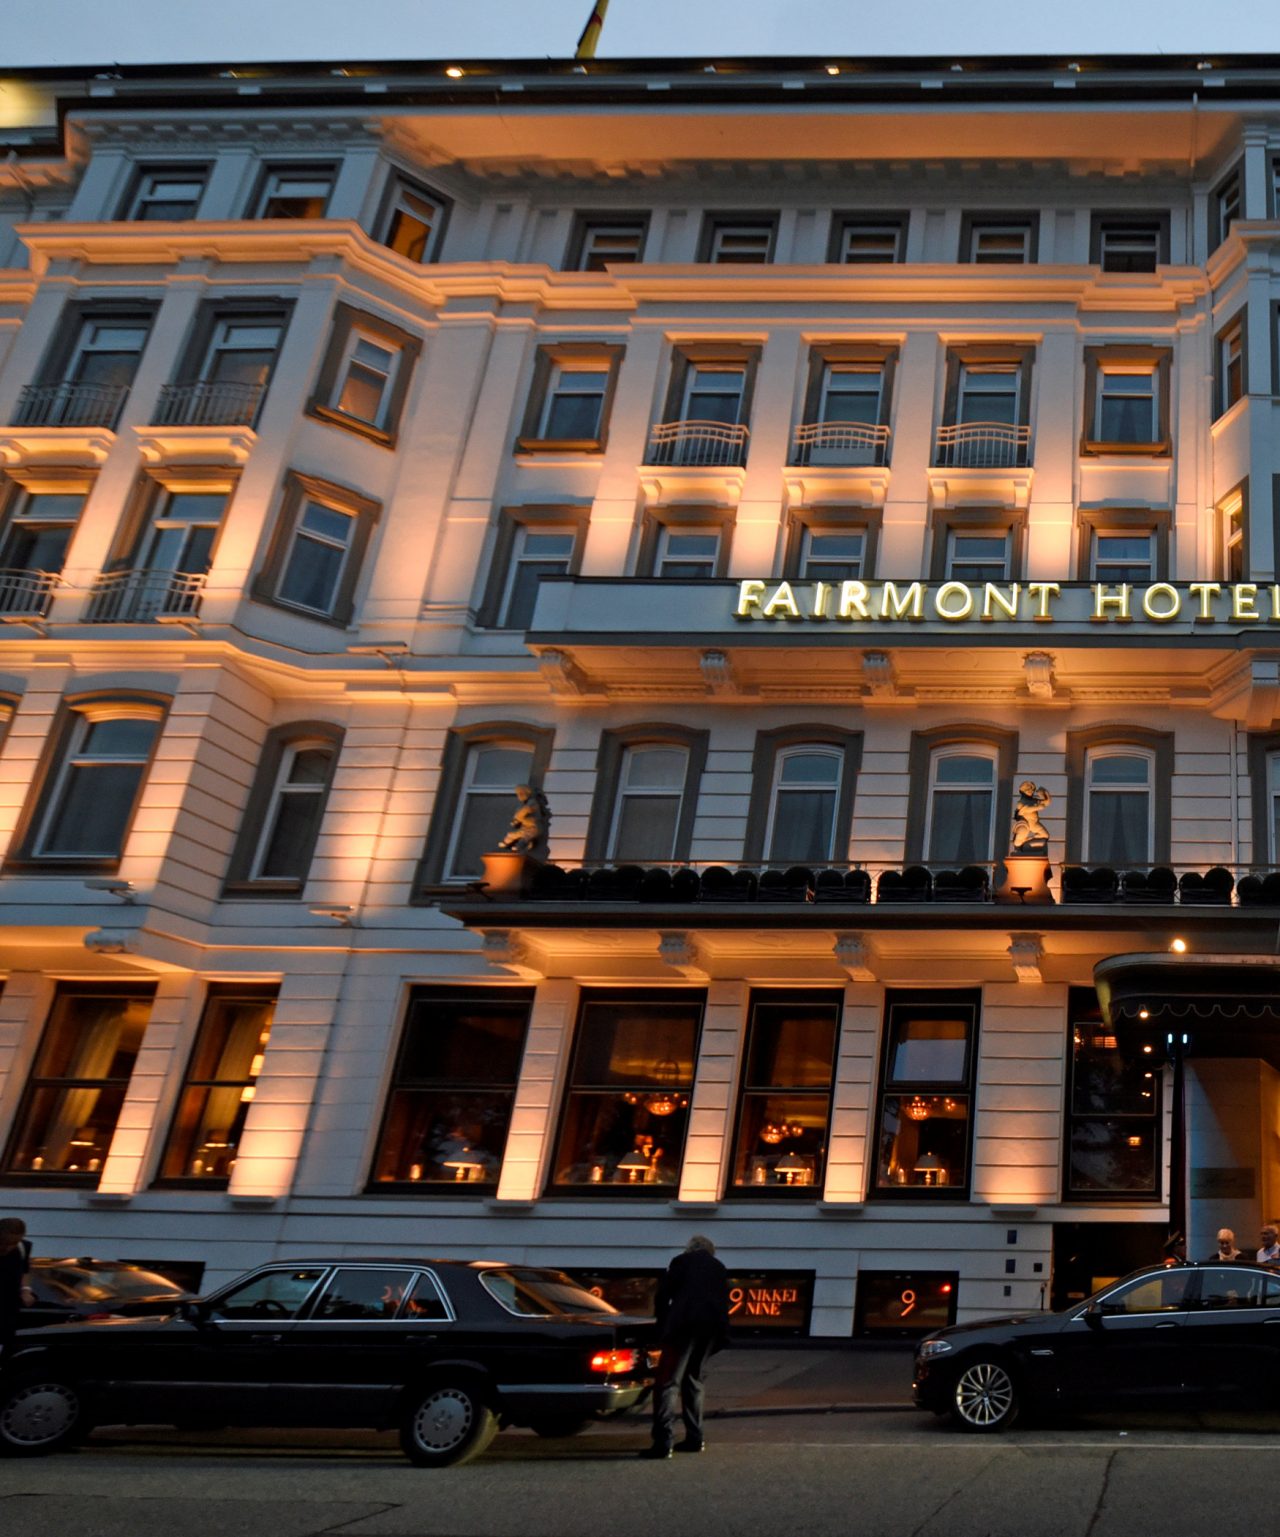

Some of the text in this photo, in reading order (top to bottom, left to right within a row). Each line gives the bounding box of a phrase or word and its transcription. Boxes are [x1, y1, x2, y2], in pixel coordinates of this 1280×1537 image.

[733, 579, 1061, 622] FAIRMONT
[748, 1288, 798, 1302] NIKKEI
[745, 1302, 781, 1315] NINE
